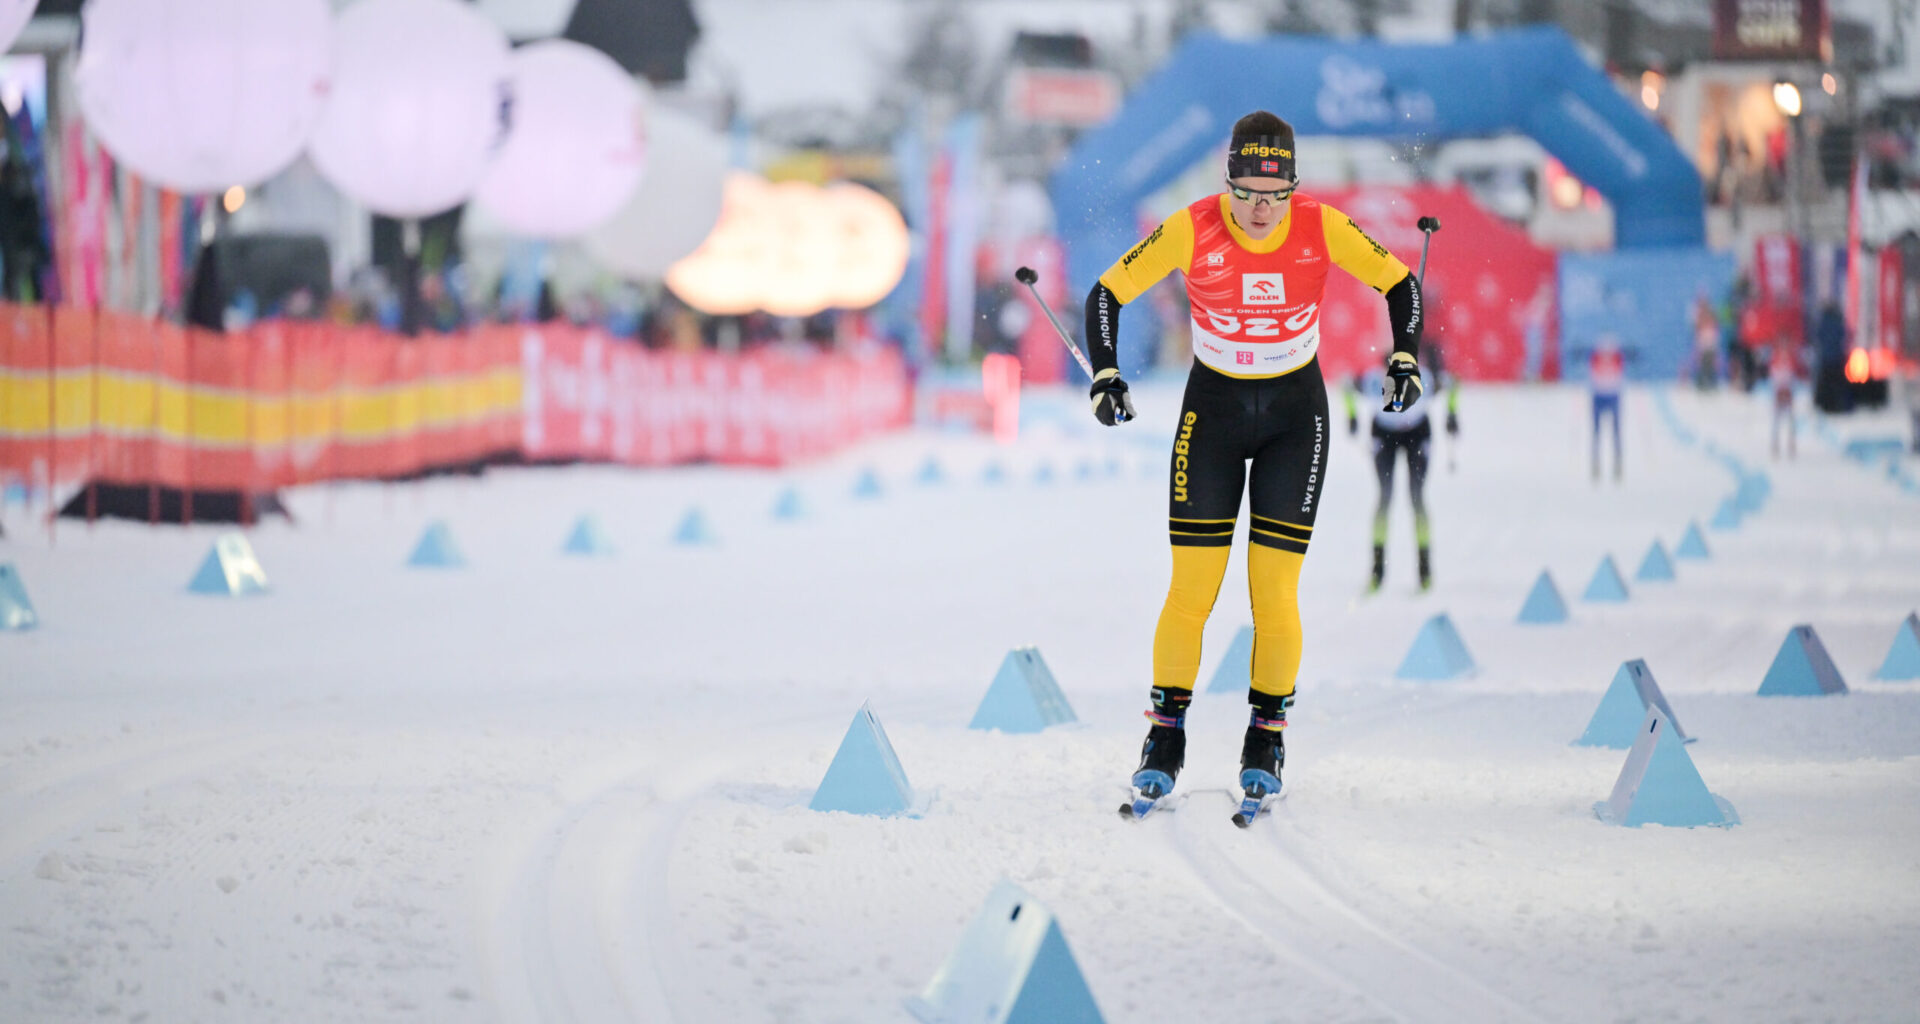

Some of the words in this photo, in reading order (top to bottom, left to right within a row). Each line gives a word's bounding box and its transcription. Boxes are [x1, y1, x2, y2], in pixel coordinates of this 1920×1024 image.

[1241, 146, 1292, 159] engcon
[1174, 411, 1197, 502] engcon
[1302, 415, 1323, 513] SWEDEMOUNT
